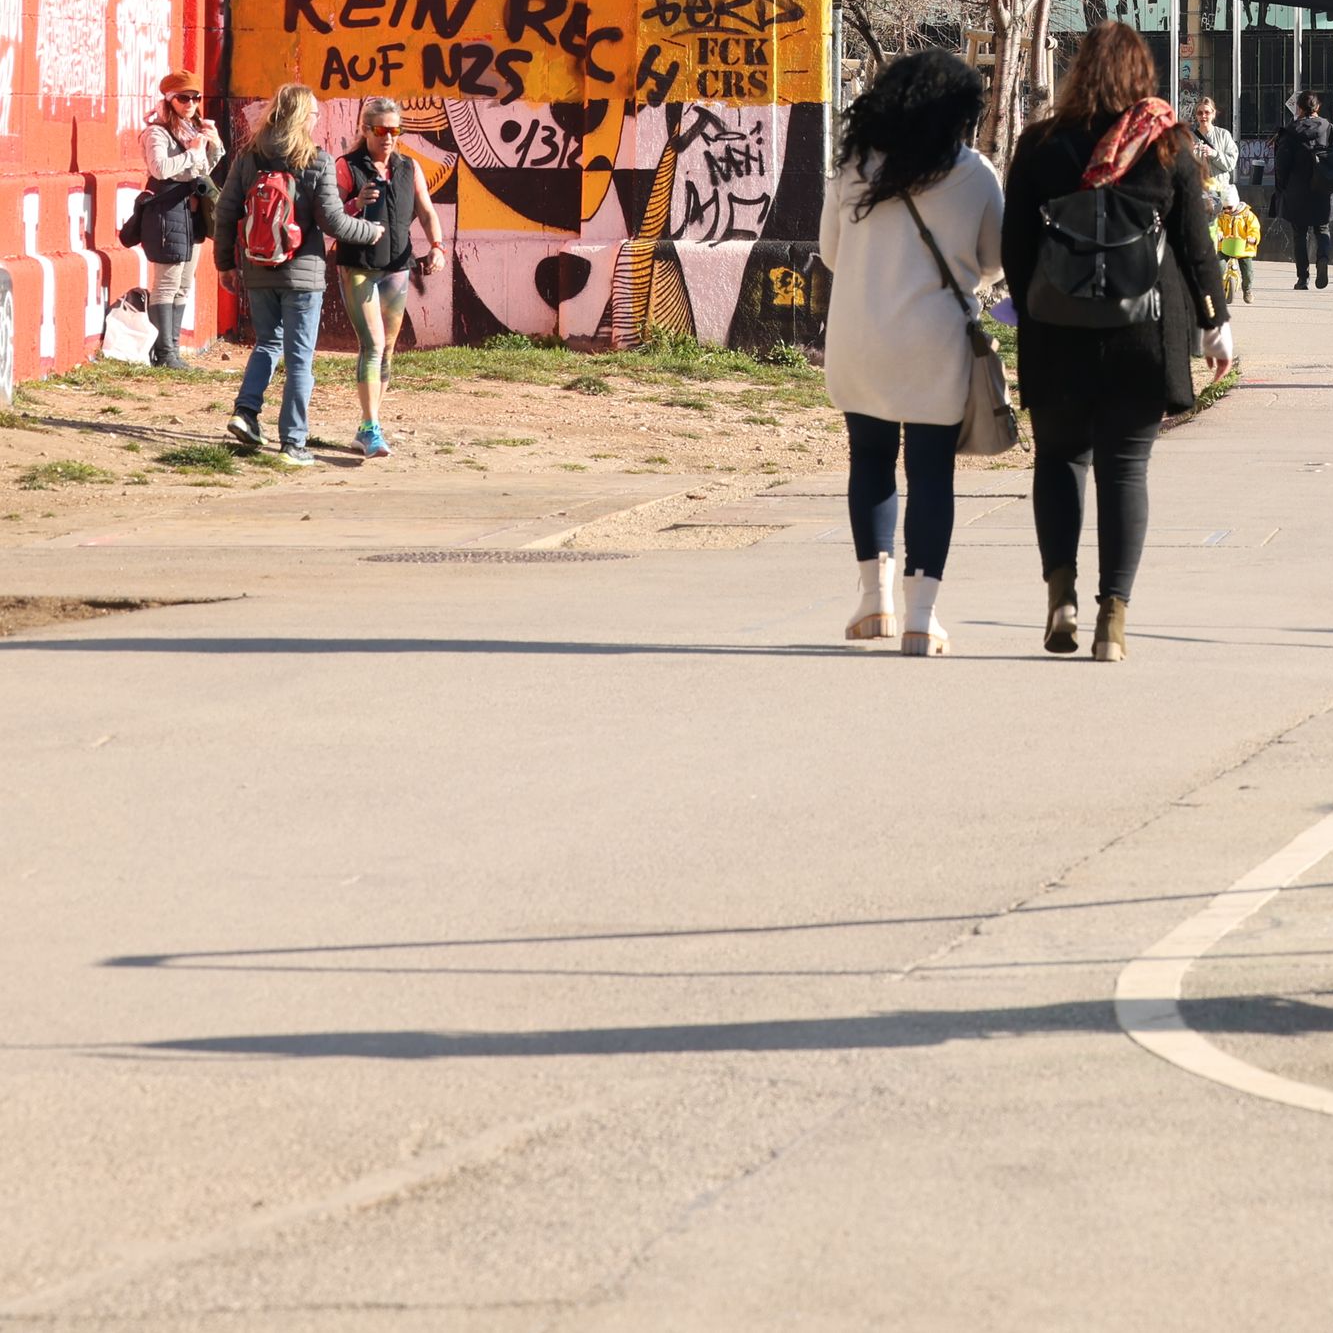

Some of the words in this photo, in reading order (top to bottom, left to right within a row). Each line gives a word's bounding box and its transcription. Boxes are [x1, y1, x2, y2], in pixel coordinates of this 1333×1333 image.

[320, 43, 406, 91] AUF
[696, 36, 769, 67] FCK
[697, 69, 769, 98] CRS
